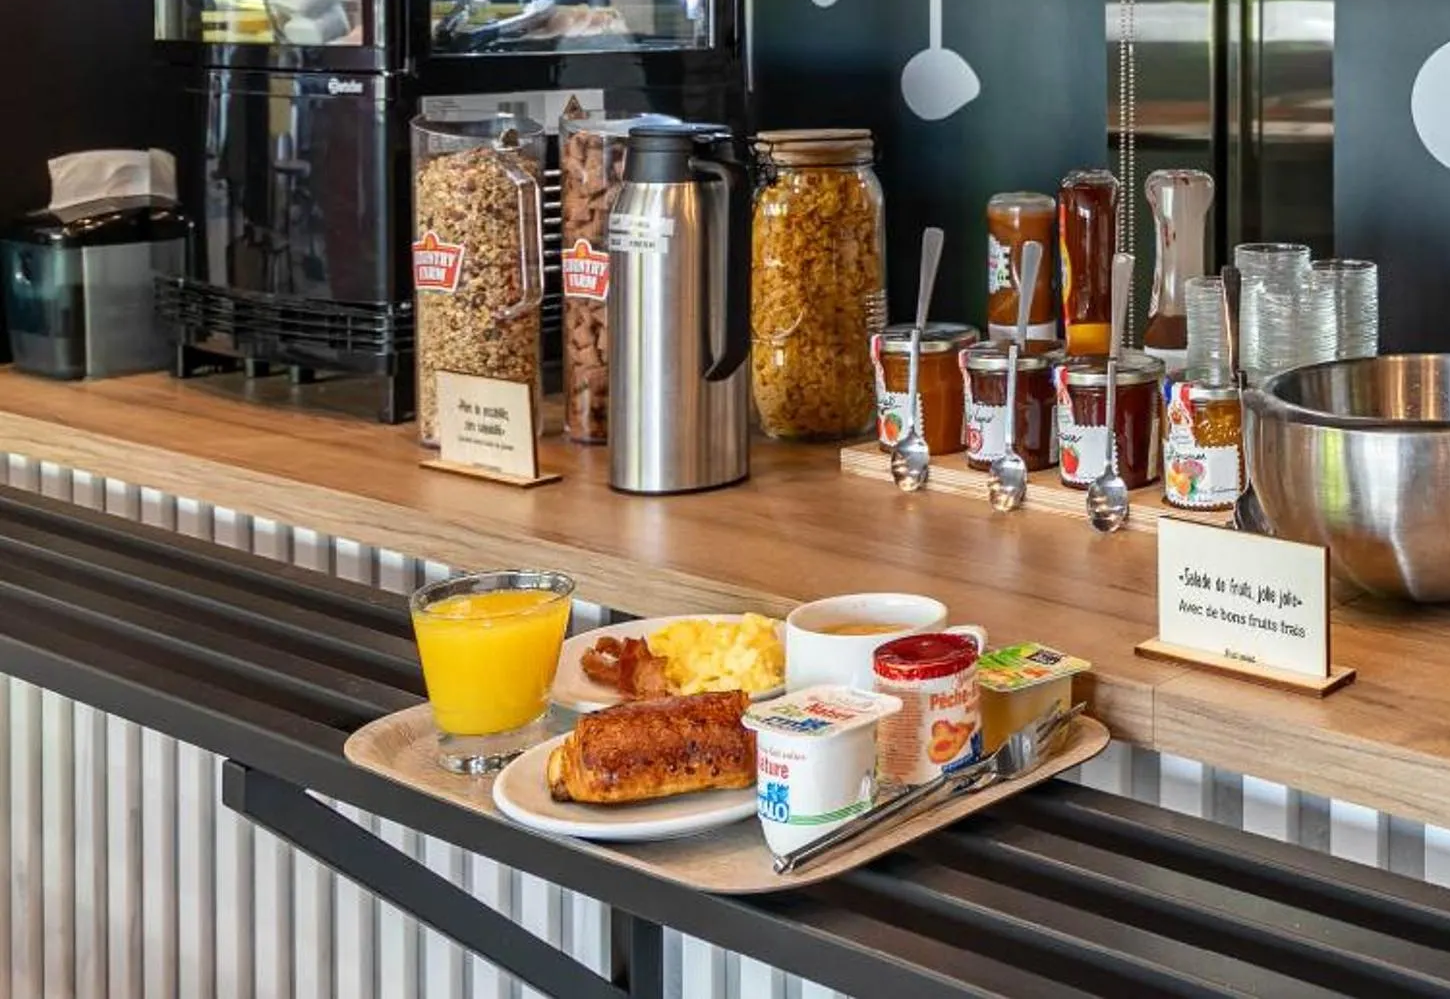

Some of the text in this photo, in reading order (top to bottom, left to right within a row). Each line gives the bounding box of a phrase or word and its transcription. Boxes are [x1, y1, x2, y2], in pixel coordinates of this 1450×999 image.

[1215, 577, 1225, 593] de
[1178, 599, 1306, 638] Avec de bons fruits frais
[758, 754, 789, 780] ature
